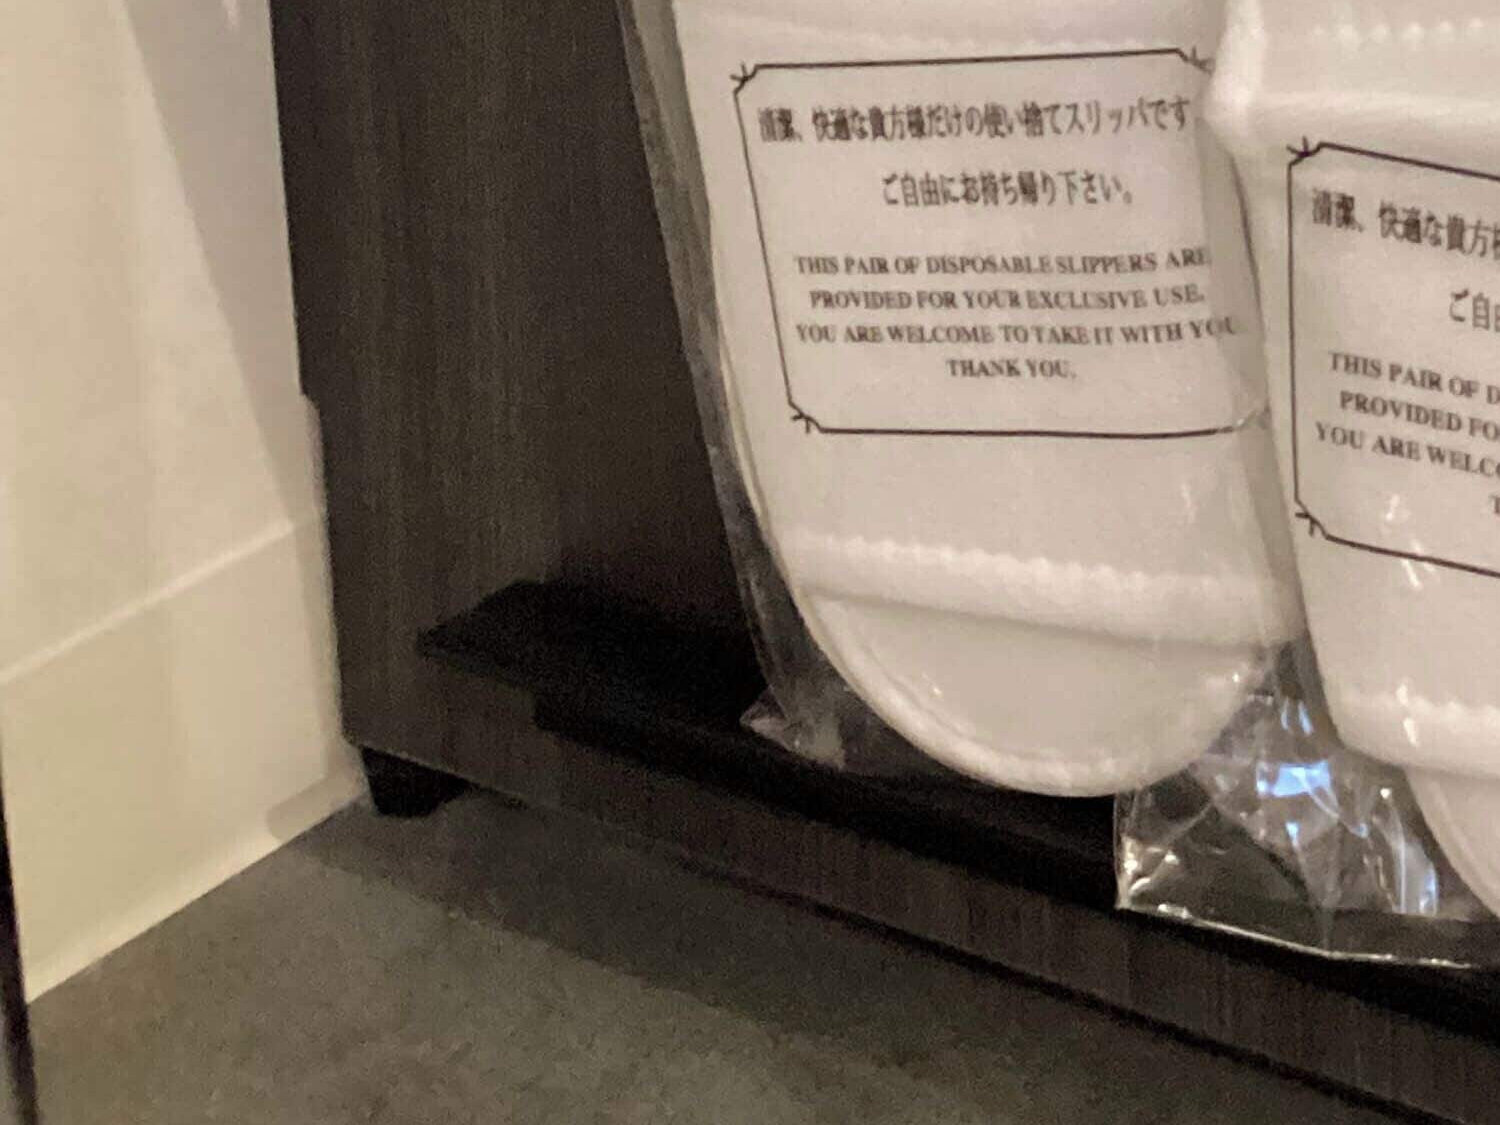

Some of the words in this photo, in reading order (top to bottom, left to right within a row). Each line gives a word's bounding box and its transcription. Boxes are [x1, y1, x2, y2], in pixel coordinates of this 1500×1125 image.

[796, 256, 838, 274] THIS
[844, 257, 889, 275] PAIR
[895, 256, 919, 275] OF
[926, 256, 1055, 275] DISPOSABLE
[1056, 253, 1156, 273] SLIPPERS
[1166, 248, 1209, 269] ARE
[810, 291, 912, 309] PROVIDED
[917, 291, 957, 309] FOR
[963, 291, 1021, 309] YOUR
[1027, 289, 1148, 309] EXCLUSIVE
[1154, 285, 1204, 306] USE.
[796, 324, 836, 343] YOU
[843, 324, 883, 343] ARE
[887, 324, 993, 344] WELCOME
[999, 325, 1029, 344] TO
[1033, 325, 1090, 344] TAKE
[1095, 325, 1115, 345] IT
[1120, 323, 1182, 344] WITH
[946, 359, 1021, 377] THANK
[1328, 351, 1382, 380] THIS
[1388, 363, 1443, 392] PAIR
[1449, 375, 1480, 398] OF
[1339, 390, 1463, 433] PROVIDED
[1315, 422, 1365, 451] YOU
[1371, 435, 1422, 461] ARE
